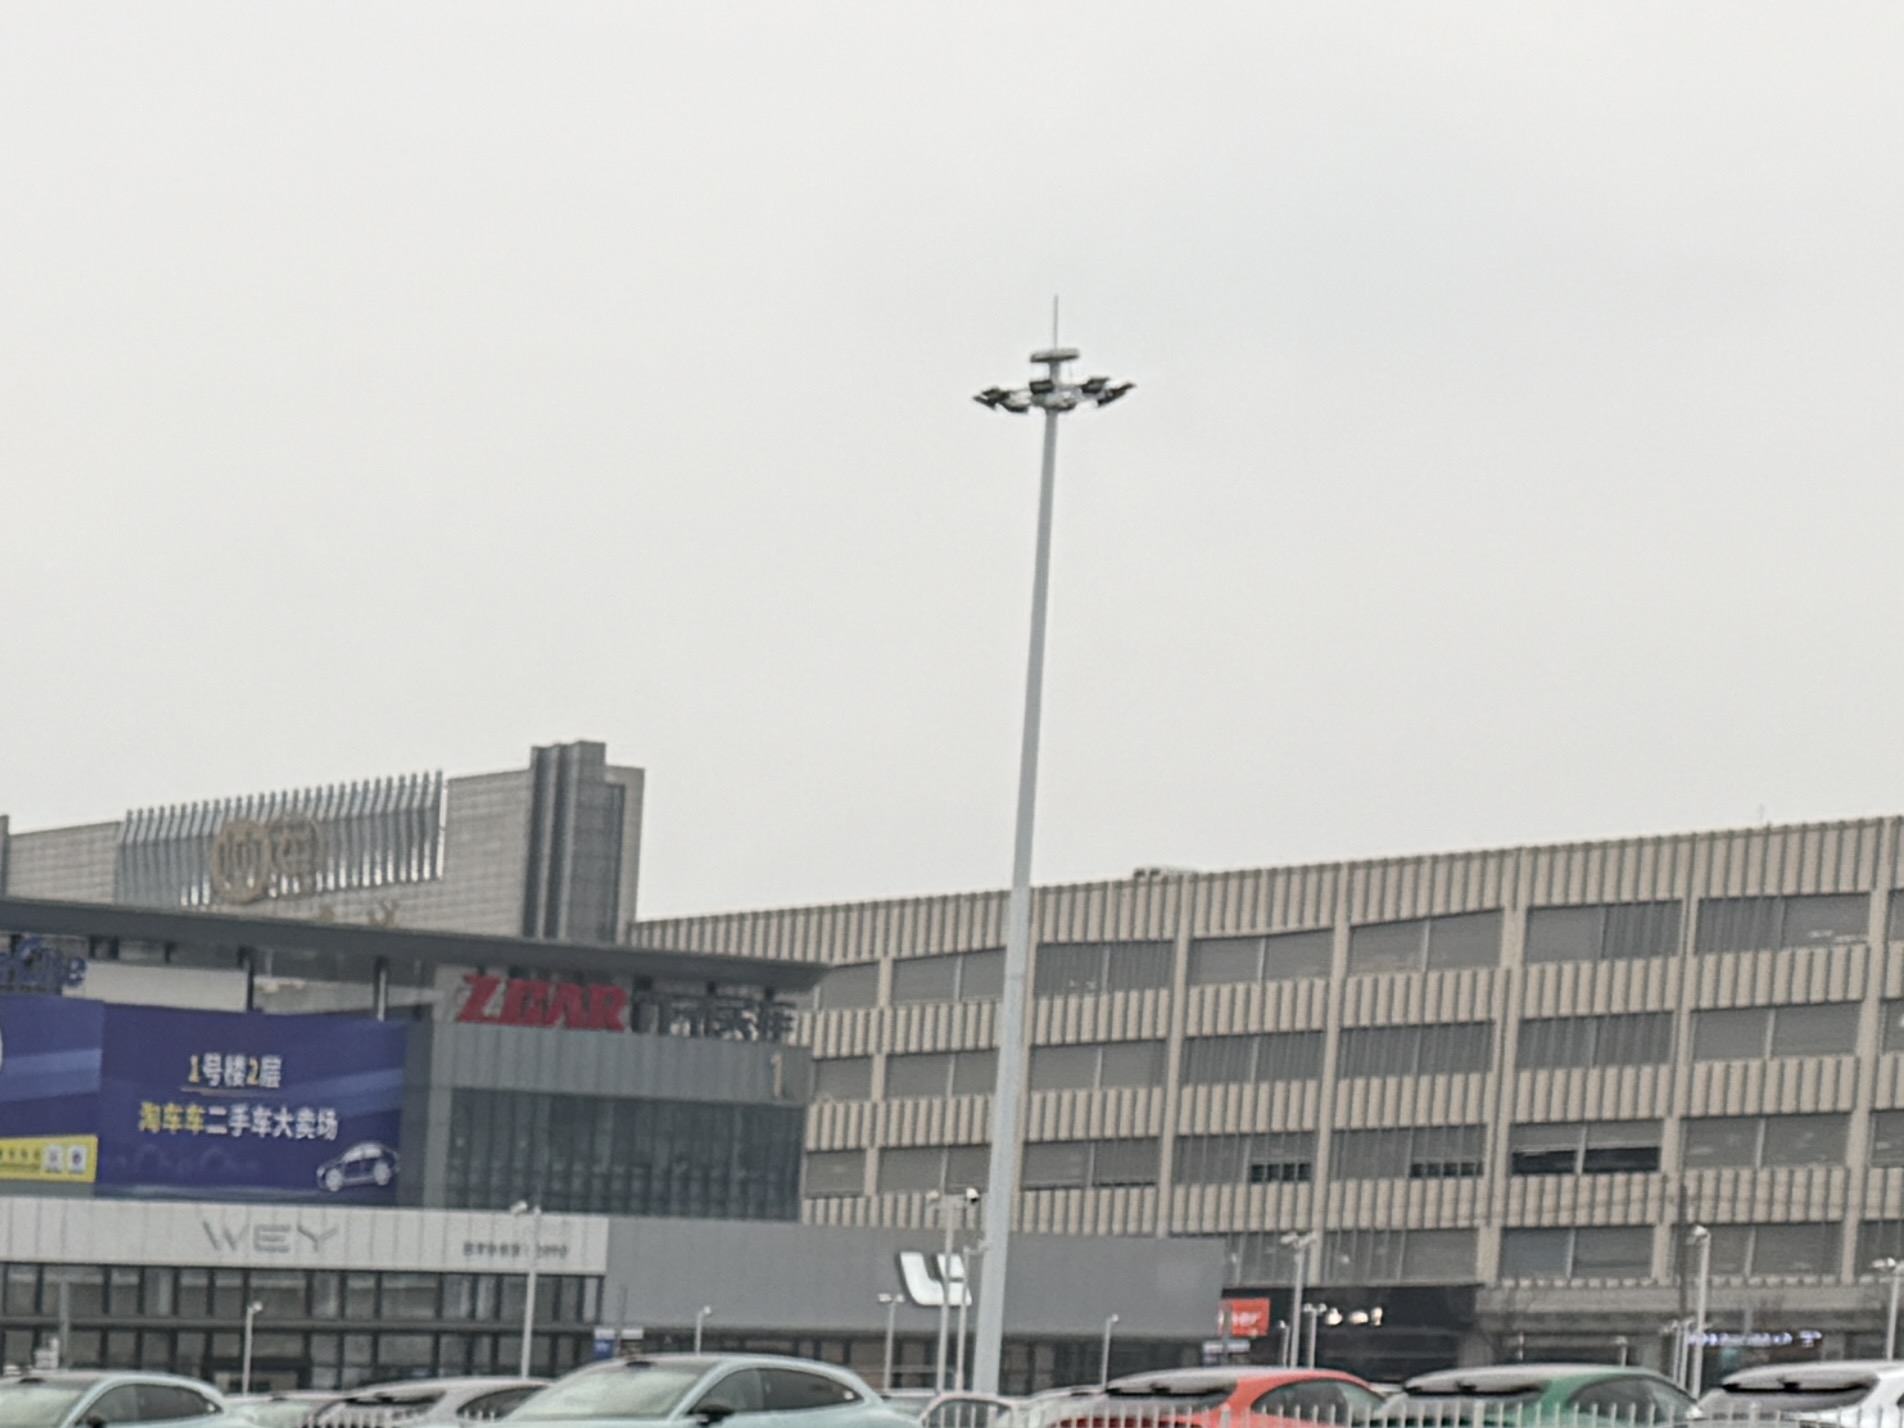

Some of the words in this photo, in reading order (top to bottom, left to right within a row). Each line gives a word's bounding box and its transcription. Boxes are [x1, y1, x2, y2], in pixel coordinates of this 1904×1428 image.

[188, 1052, 282, 1089] 1号楼2层
[138, 1100, 339, 1142] 淘车车二手车大卖场
[202, 1220, 339, 1254] WEY
